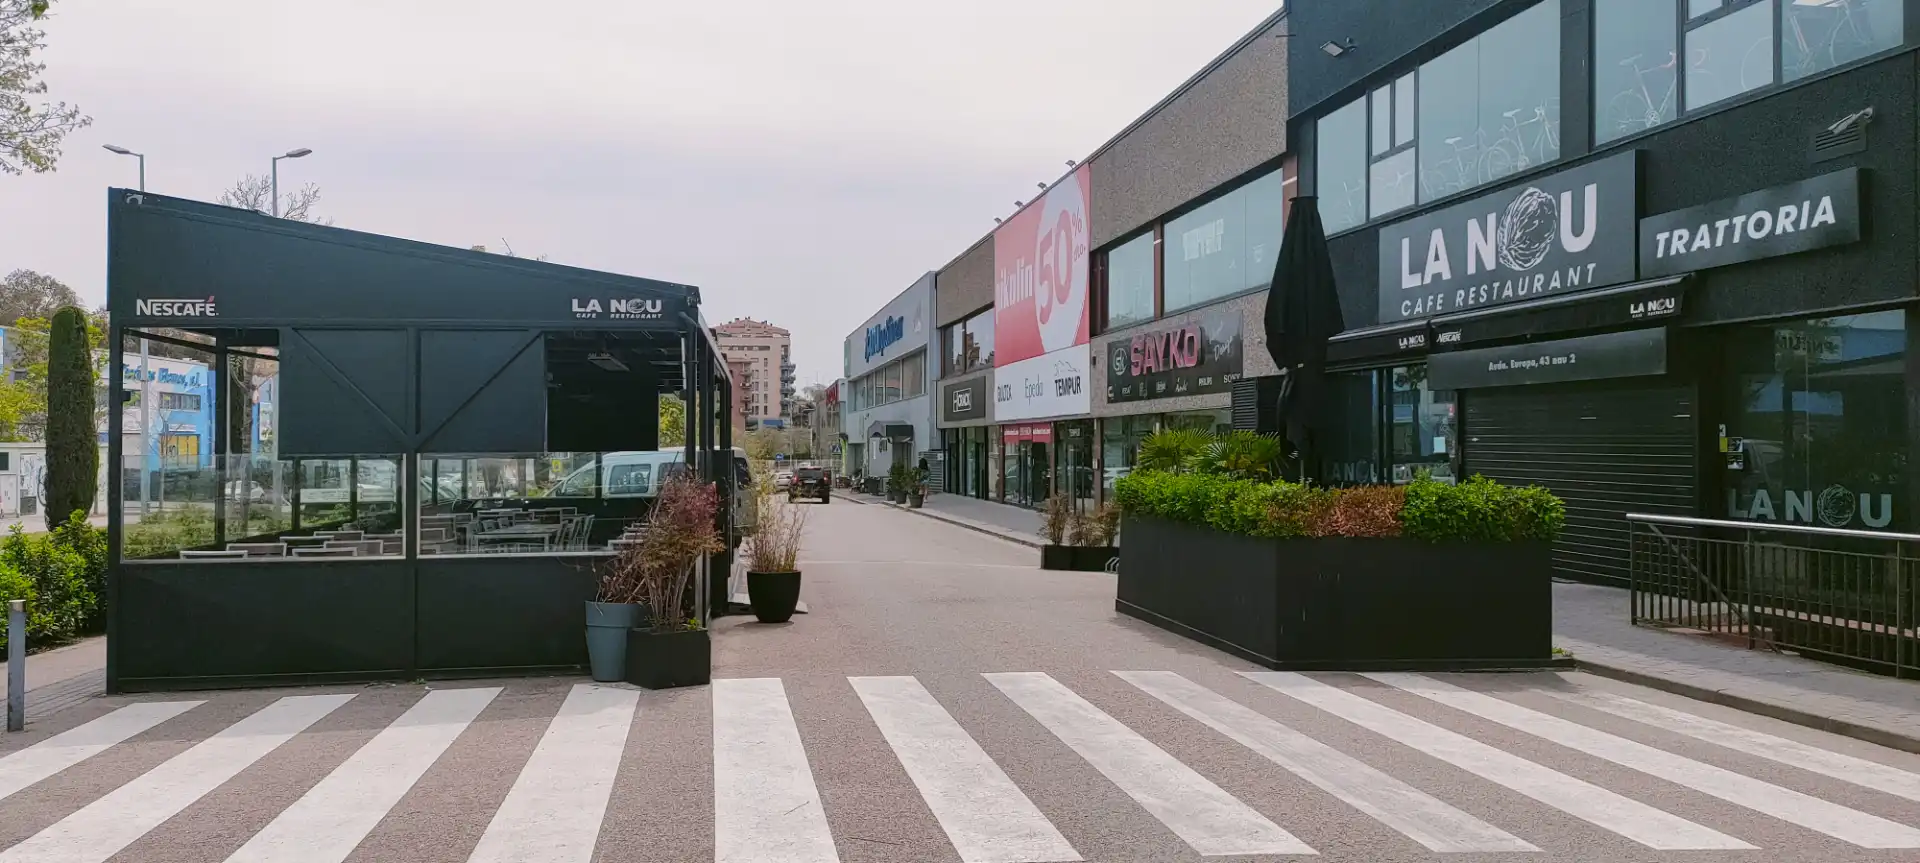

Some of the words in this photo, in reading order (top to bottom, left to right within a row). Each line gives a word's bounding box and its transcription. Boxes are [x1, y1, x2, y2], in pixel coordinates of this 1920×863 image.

[1401, 228, 1452, 290] LA
[1467, 182, 1598, 276] NOU
[1655, 195, 1836, 259] TRATTORIA
[1401, 292, 1444, 316] CAFE
[1455, 263, 1597, 308] RESTAURANT
[136, 295, 217, 316] NESCAFÉ
[571, 298, 603, 313] LA
[610, 298, 662, 313] NOU
[1630, 302, 1645, 314] LA
[1130, 323, 1201, 377] SAYKO
[1510, 359, 1539, 369] Europa,
[1539, 355, 1550, 366] 43
[1552, 356, 1567, 365] nau
[1569, 353, 1576, 363] 2
[1054, 375, 1082, 398] TEMPUR
[1728, 488, 1776, 521] LA
